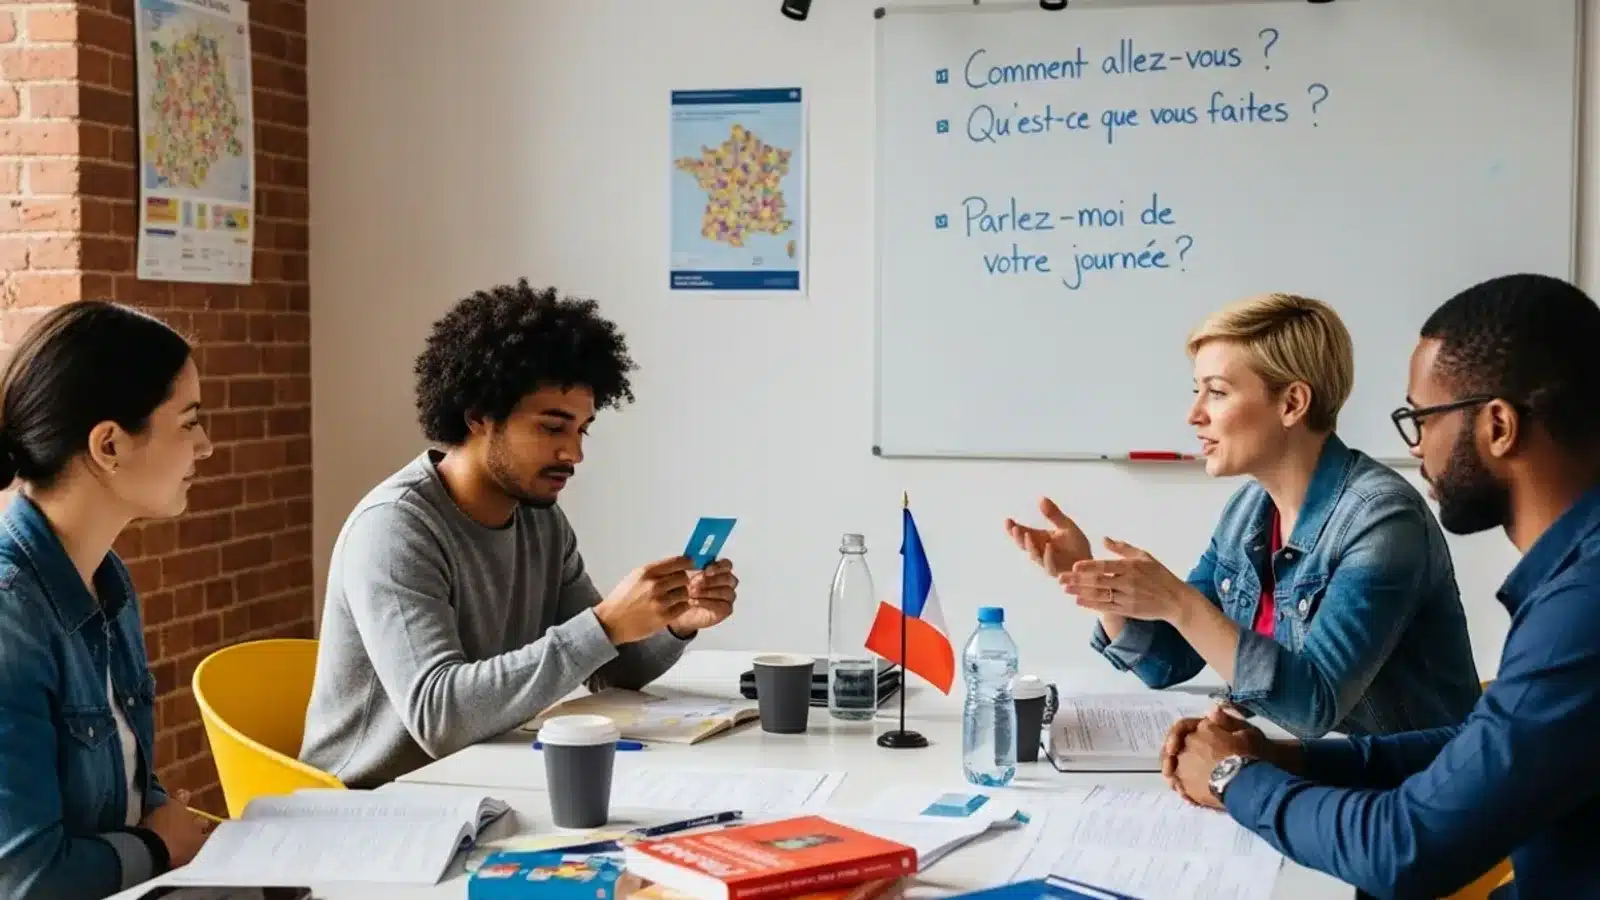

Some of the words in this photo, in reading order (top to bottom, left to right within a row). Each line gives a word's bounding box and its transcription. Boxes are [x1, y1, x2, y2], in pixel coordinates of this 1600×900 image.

[964, 46, 1089, 89] Comment
[1101, 38, 1243, 74] allez-vous
[966, 102, 1091, 144] Qu'est-ce
[1101, 109, 1140, 145] que
[1149, 106, 1199, 125] vous
[1206, 91, 1289, 124] faites
[1307, 82, 1329, 128] ?
[961, 195, 1125, 238] Parlez-moi
[1140, 192, 1176, 226] de
[983, 243, 1052, 275] votre
